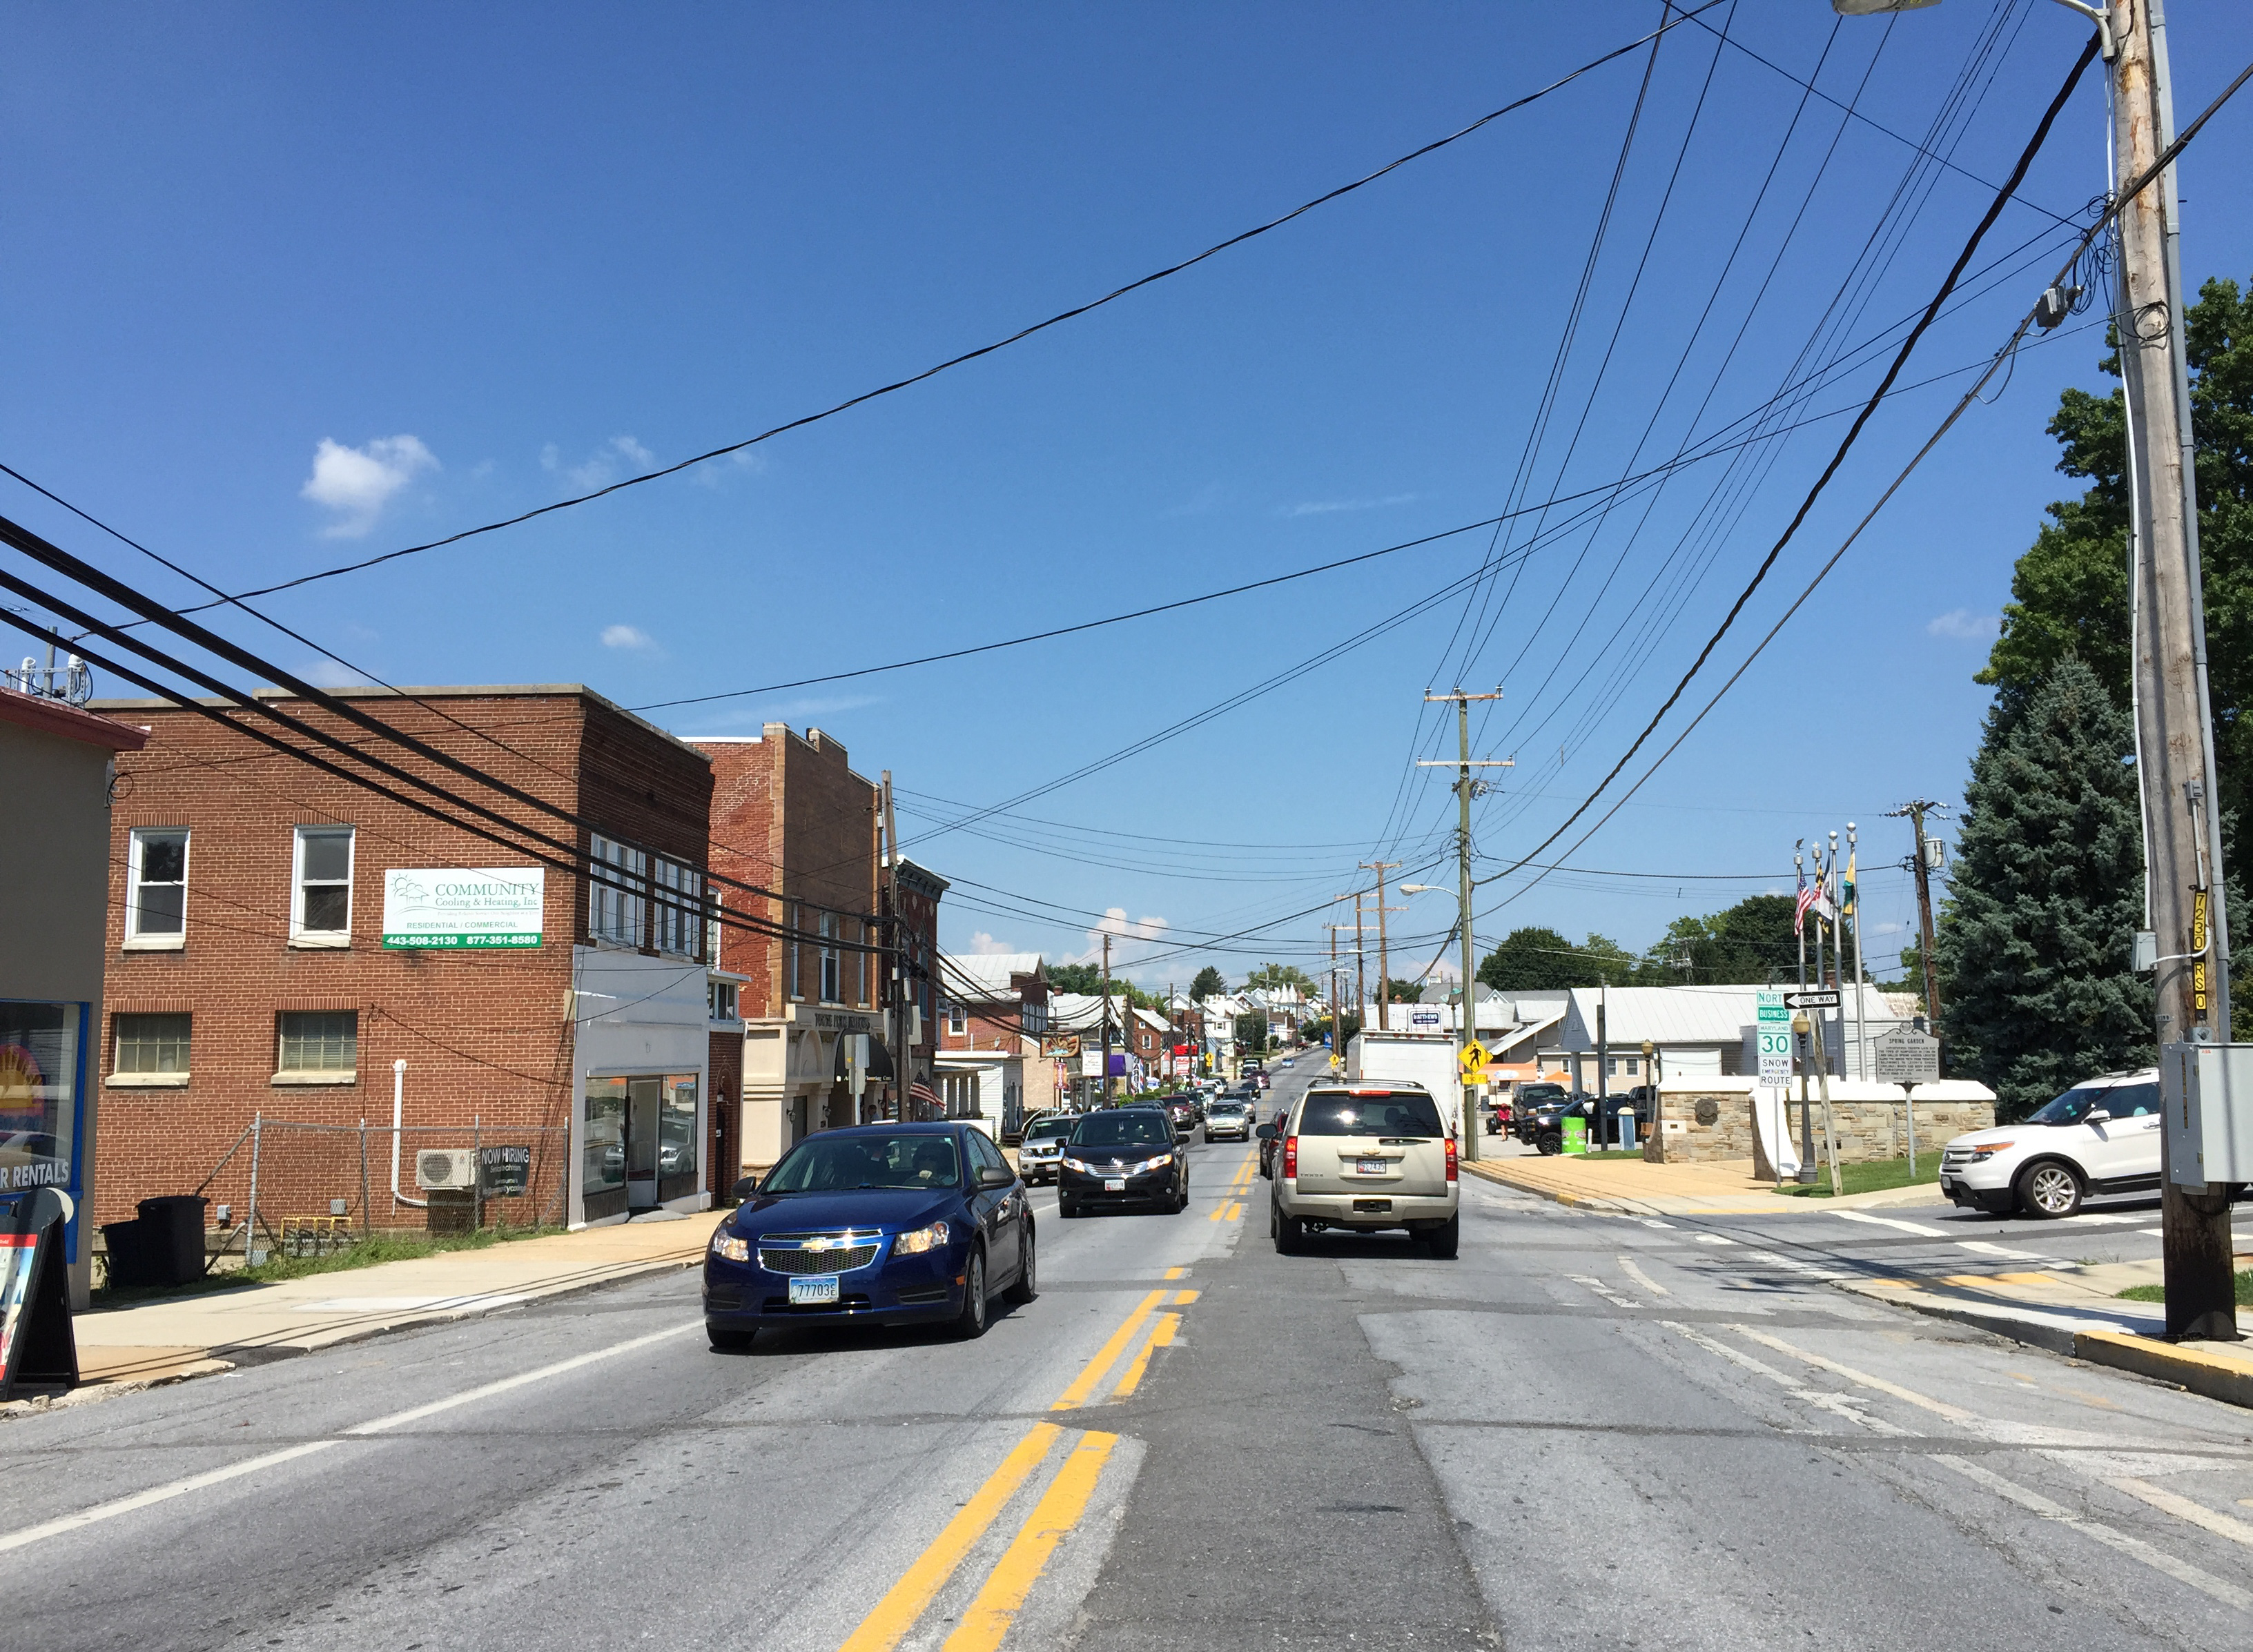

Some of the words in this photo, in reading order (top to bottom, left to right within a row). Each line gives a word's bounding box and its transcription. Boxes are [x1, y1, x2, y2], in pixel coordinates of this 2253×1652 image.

[436, 883, 540, 896] COMMUNITY
[436, 897, 470, 908] Cooling
[484, 898, 521, 907] Heating,
[524, 897, 538, 905] Inc
[2195, 894, 2205, 949] 7230
[387, 936, 458, 945] 443-508-2130
[467, 936, 538, 945] 877-351-8580
[1758, 992, 1782, 1003] NORT
[1759, 1010, 1788, 1019] BUSINESS
[1762, 1035, 1788, 1053] 30
[482, 1148, 500, 1165] NOW
[502, 1148, 529, 1163] HIRING
[13, 1161, 69, 1188] RENTALS
